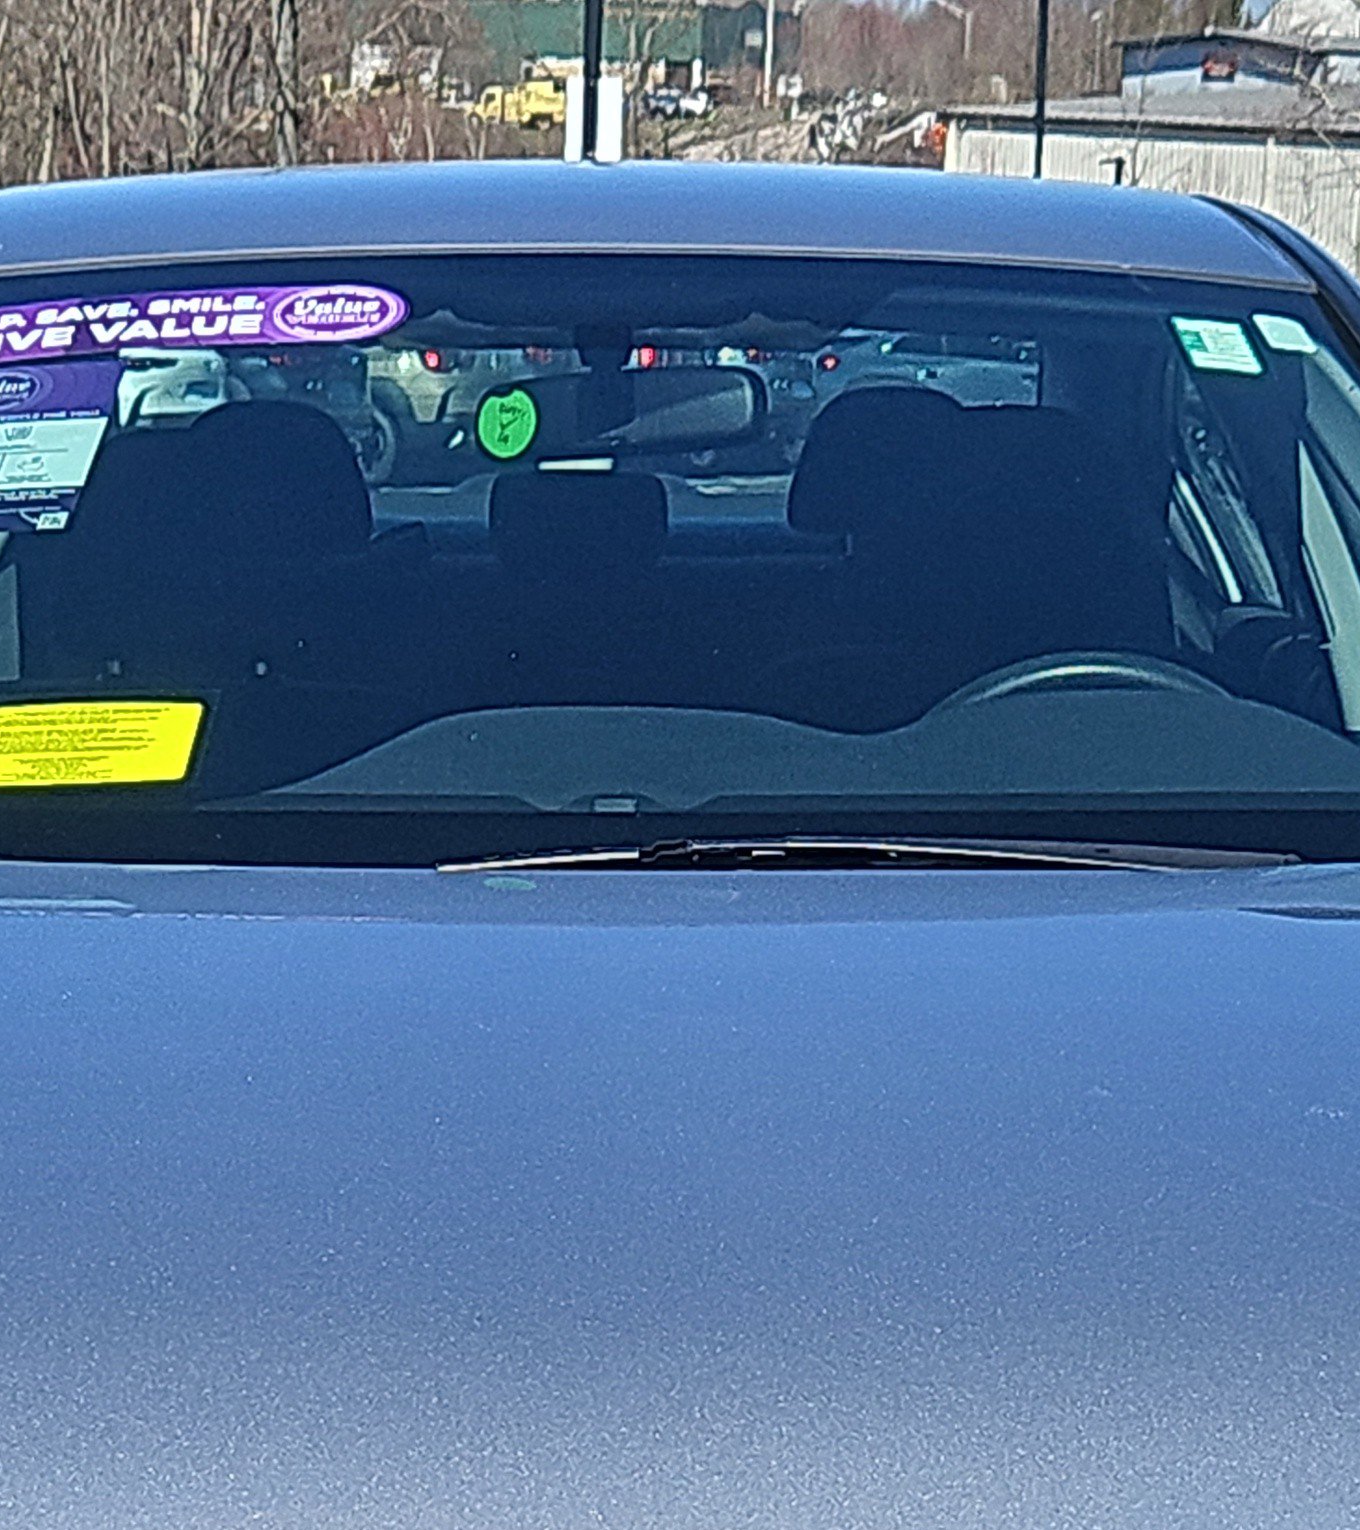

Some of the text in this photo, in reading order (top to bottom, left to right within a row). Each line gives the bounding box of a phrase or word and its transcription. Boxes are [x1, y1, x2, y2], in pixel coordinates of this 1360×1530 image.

[35, 301, 139, 325] SAVE.
[147, 295, 265, 315] SMILE.
[293, 297, 381, 316] Value
[90, 313, 264, 343] VALUE
